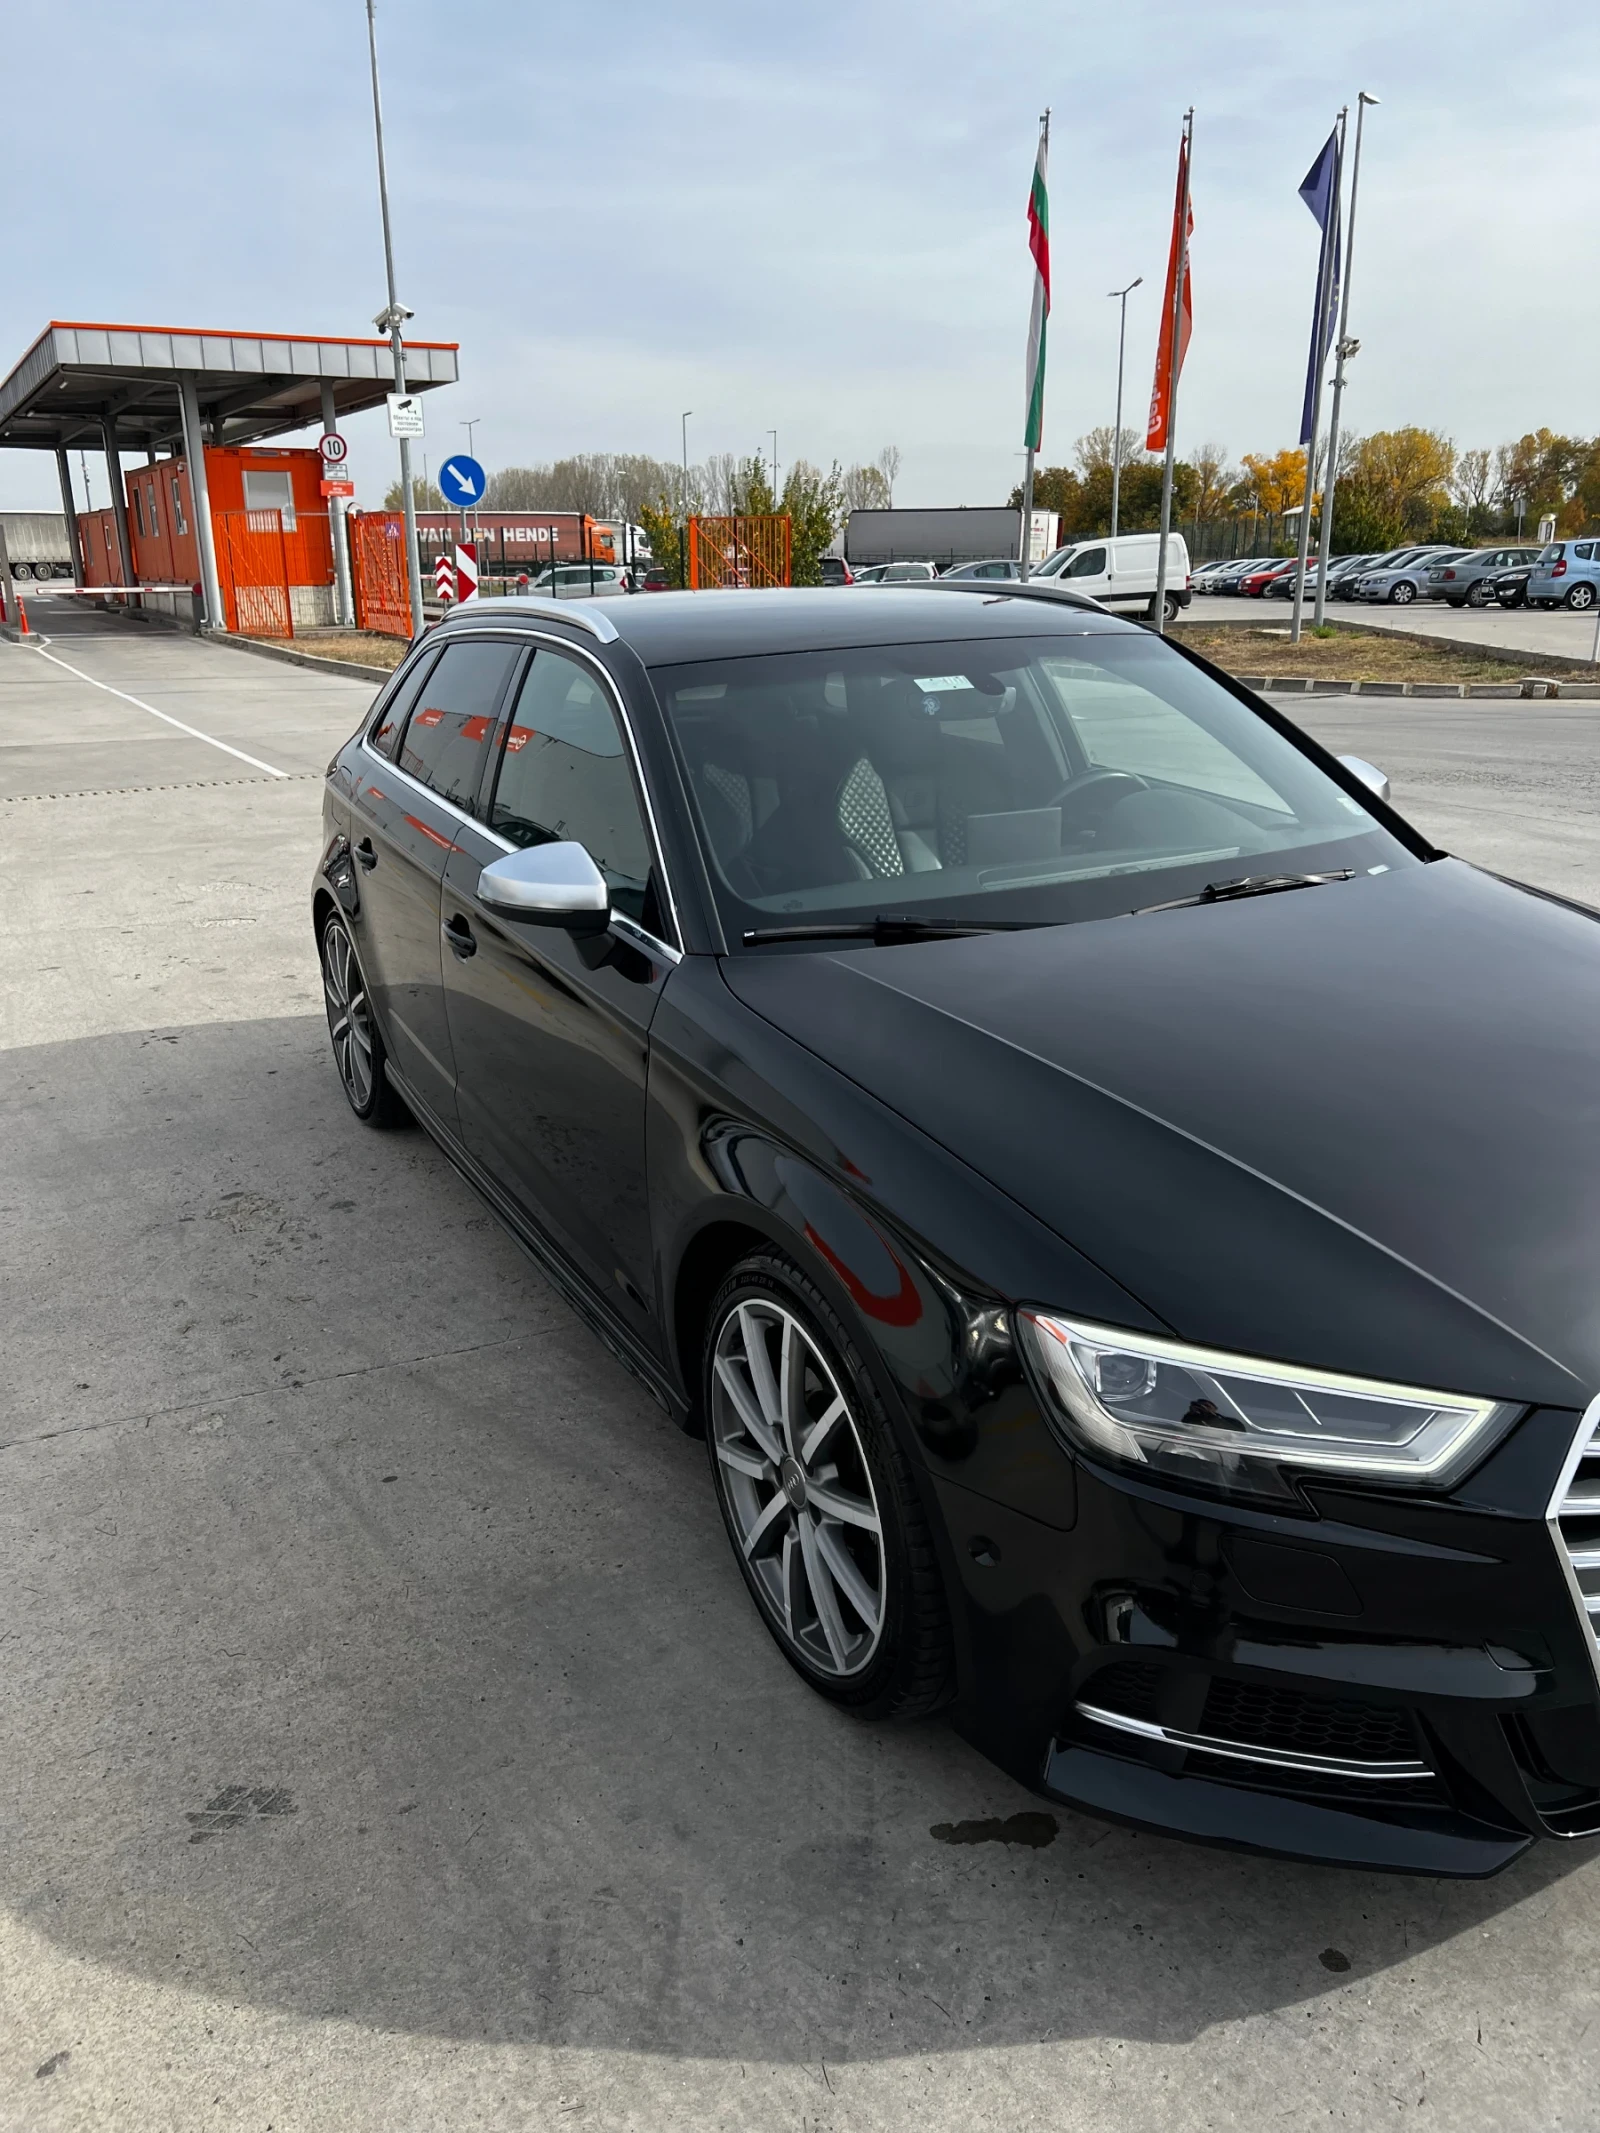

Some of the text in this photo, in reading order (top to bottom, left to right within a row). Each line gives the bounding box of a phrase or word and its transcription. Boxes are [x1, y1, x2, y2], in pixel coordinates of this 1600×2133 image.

[327, 440, 341, 456] 10
[415, 527, 559, 543] VAN DEN HENDE
